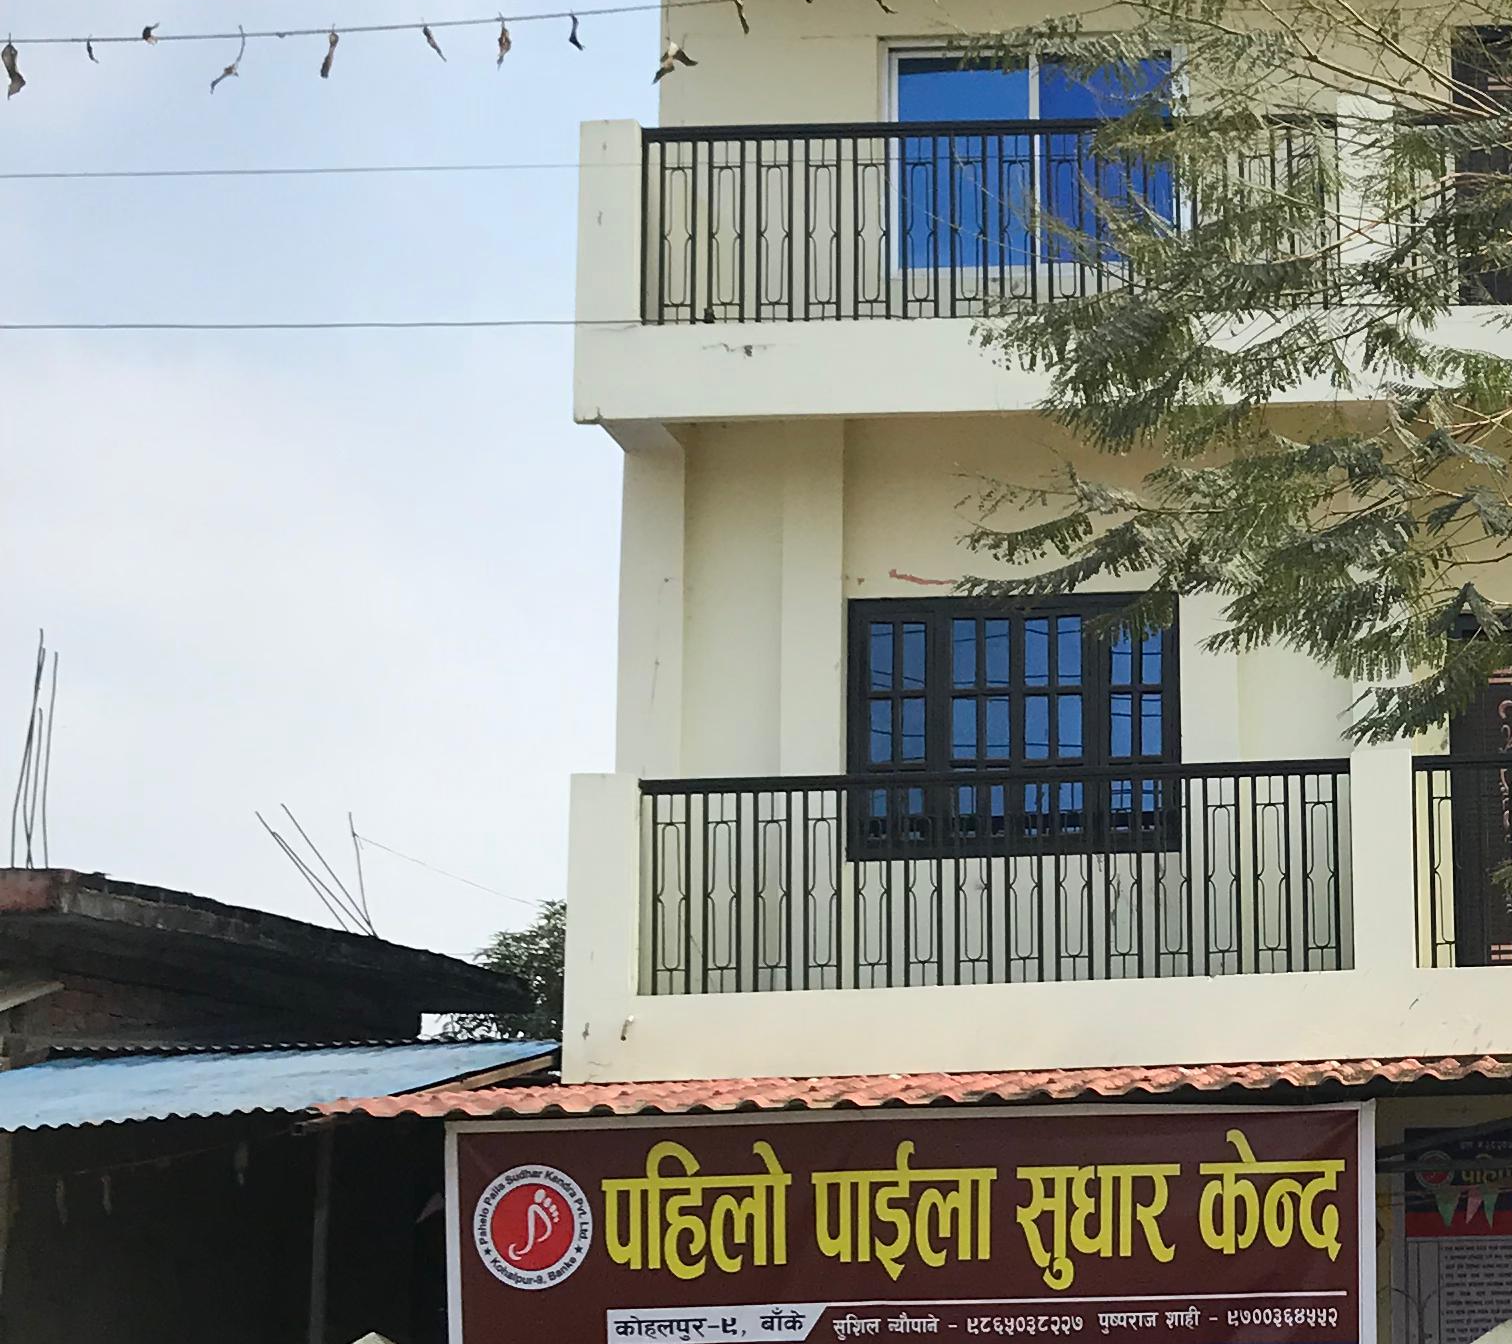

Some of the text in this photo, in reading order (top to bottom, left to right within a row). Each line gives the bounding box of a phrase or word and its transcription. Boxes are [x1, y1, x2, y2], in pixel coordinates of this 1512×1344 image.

[478, 1207, 490, 1245] Pahelo
[601, 1140, 792, 1279] पहिलो
[811, 1140, 997, 1280] पाईला
[1016, 1163, 1181, 1290] सुधार
[548, 1257, 577, 1281] Banke
[760, 1308, 806, 1332] बाँके
[833, 1314, 881, 1341] सुशिल
[887, 1312, 940, 1333] न्यौपाने
[967, 1315, 1083, 1336] ९८६५०३८२२७
[1098, 1311, 1159, 1334] पुष्पराज
[1165, 1305, 1201, 1329] शाही
[1227, 1307, 1338, 1328] ९७००३६४५५२
